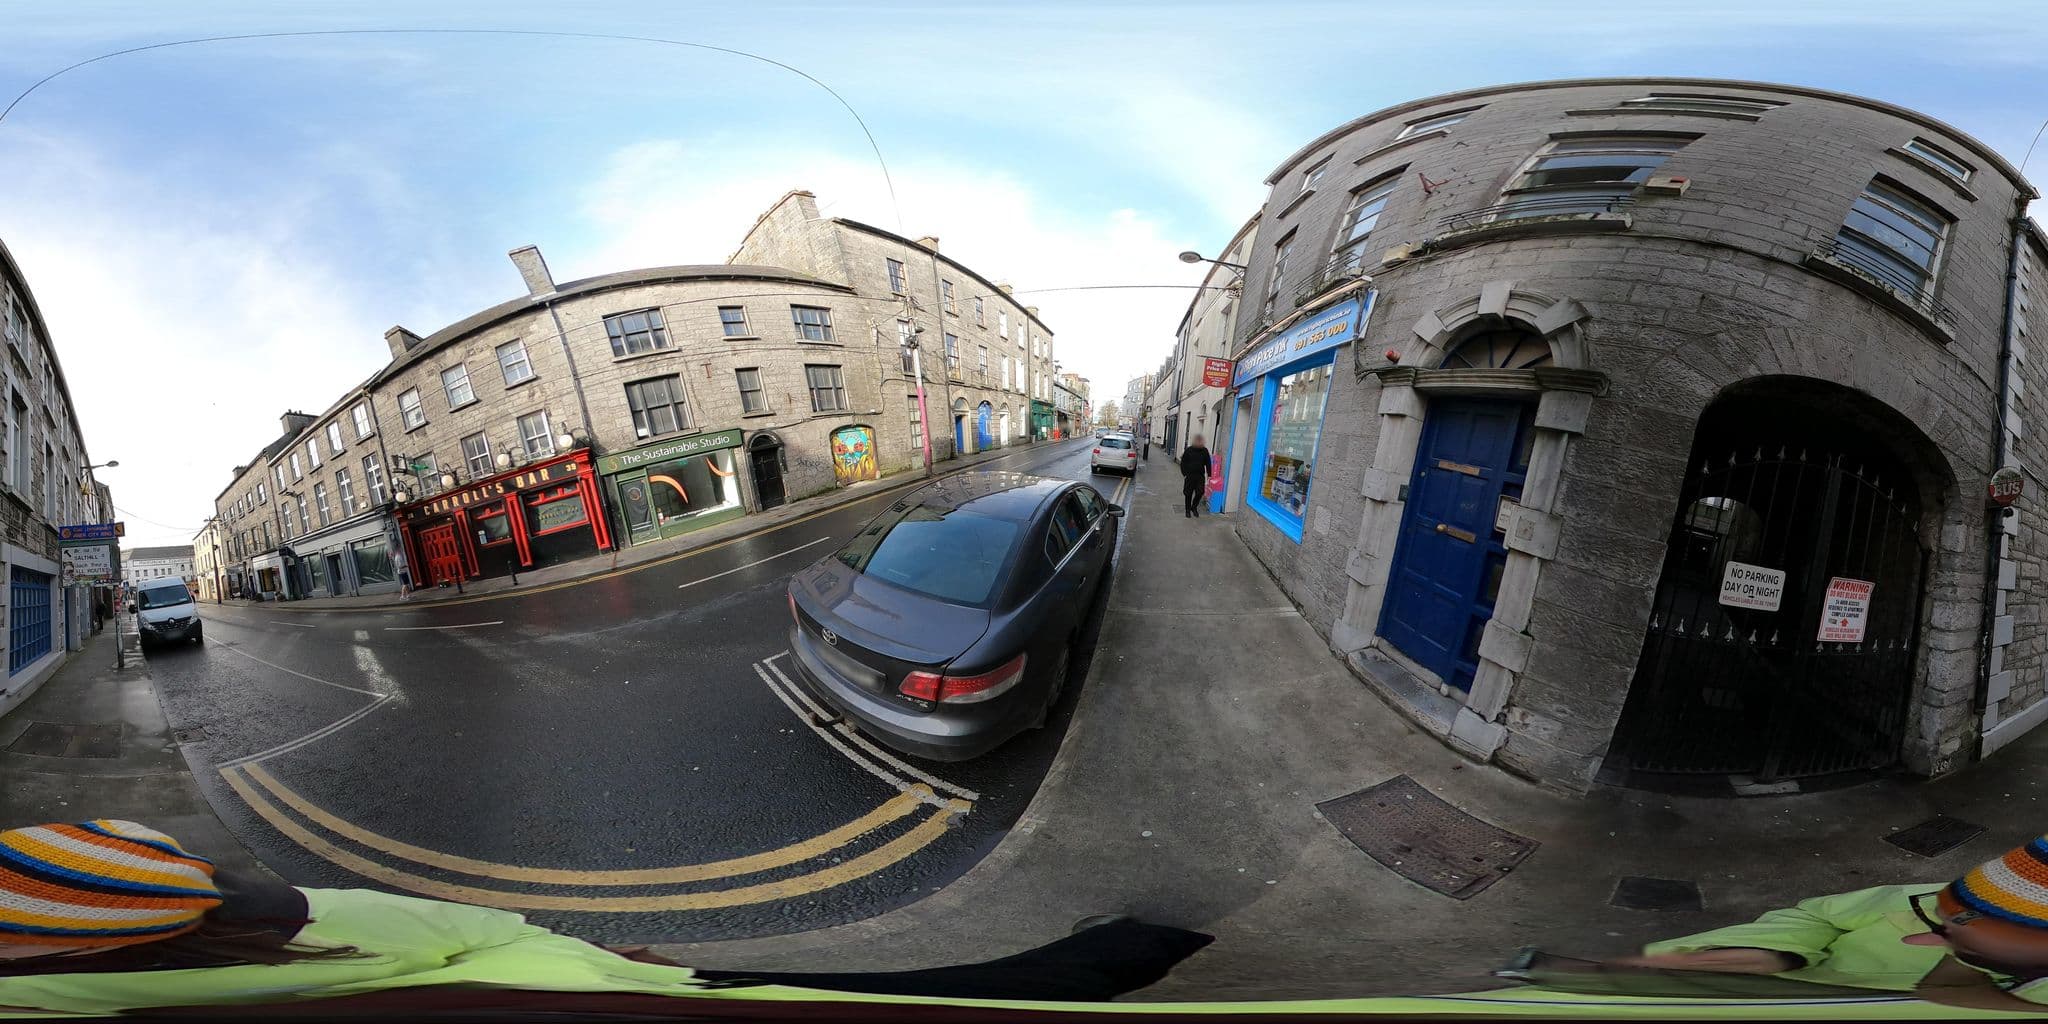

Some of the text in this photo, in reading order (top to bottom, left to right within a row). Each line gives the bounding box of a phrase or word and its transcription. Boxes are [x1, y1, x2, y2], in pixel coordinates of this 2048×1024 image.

[1327, 321, 1348, 337] 000
[620, 435, 730, 465] The Sustainable Studio
[565, 463, 577, 472] 39
[423, 468, 551, 516] CARROLL'S BAR
[1993, 481, 2021, 498] BUS
[1731, 568, 1779, 585] NO PARKING
[1724, 581, 1780, 598] DAY OR NIGHT
[1833, 580, 1870, 594] WARNING
[1845, 592, 1858, 600] BLOCK
